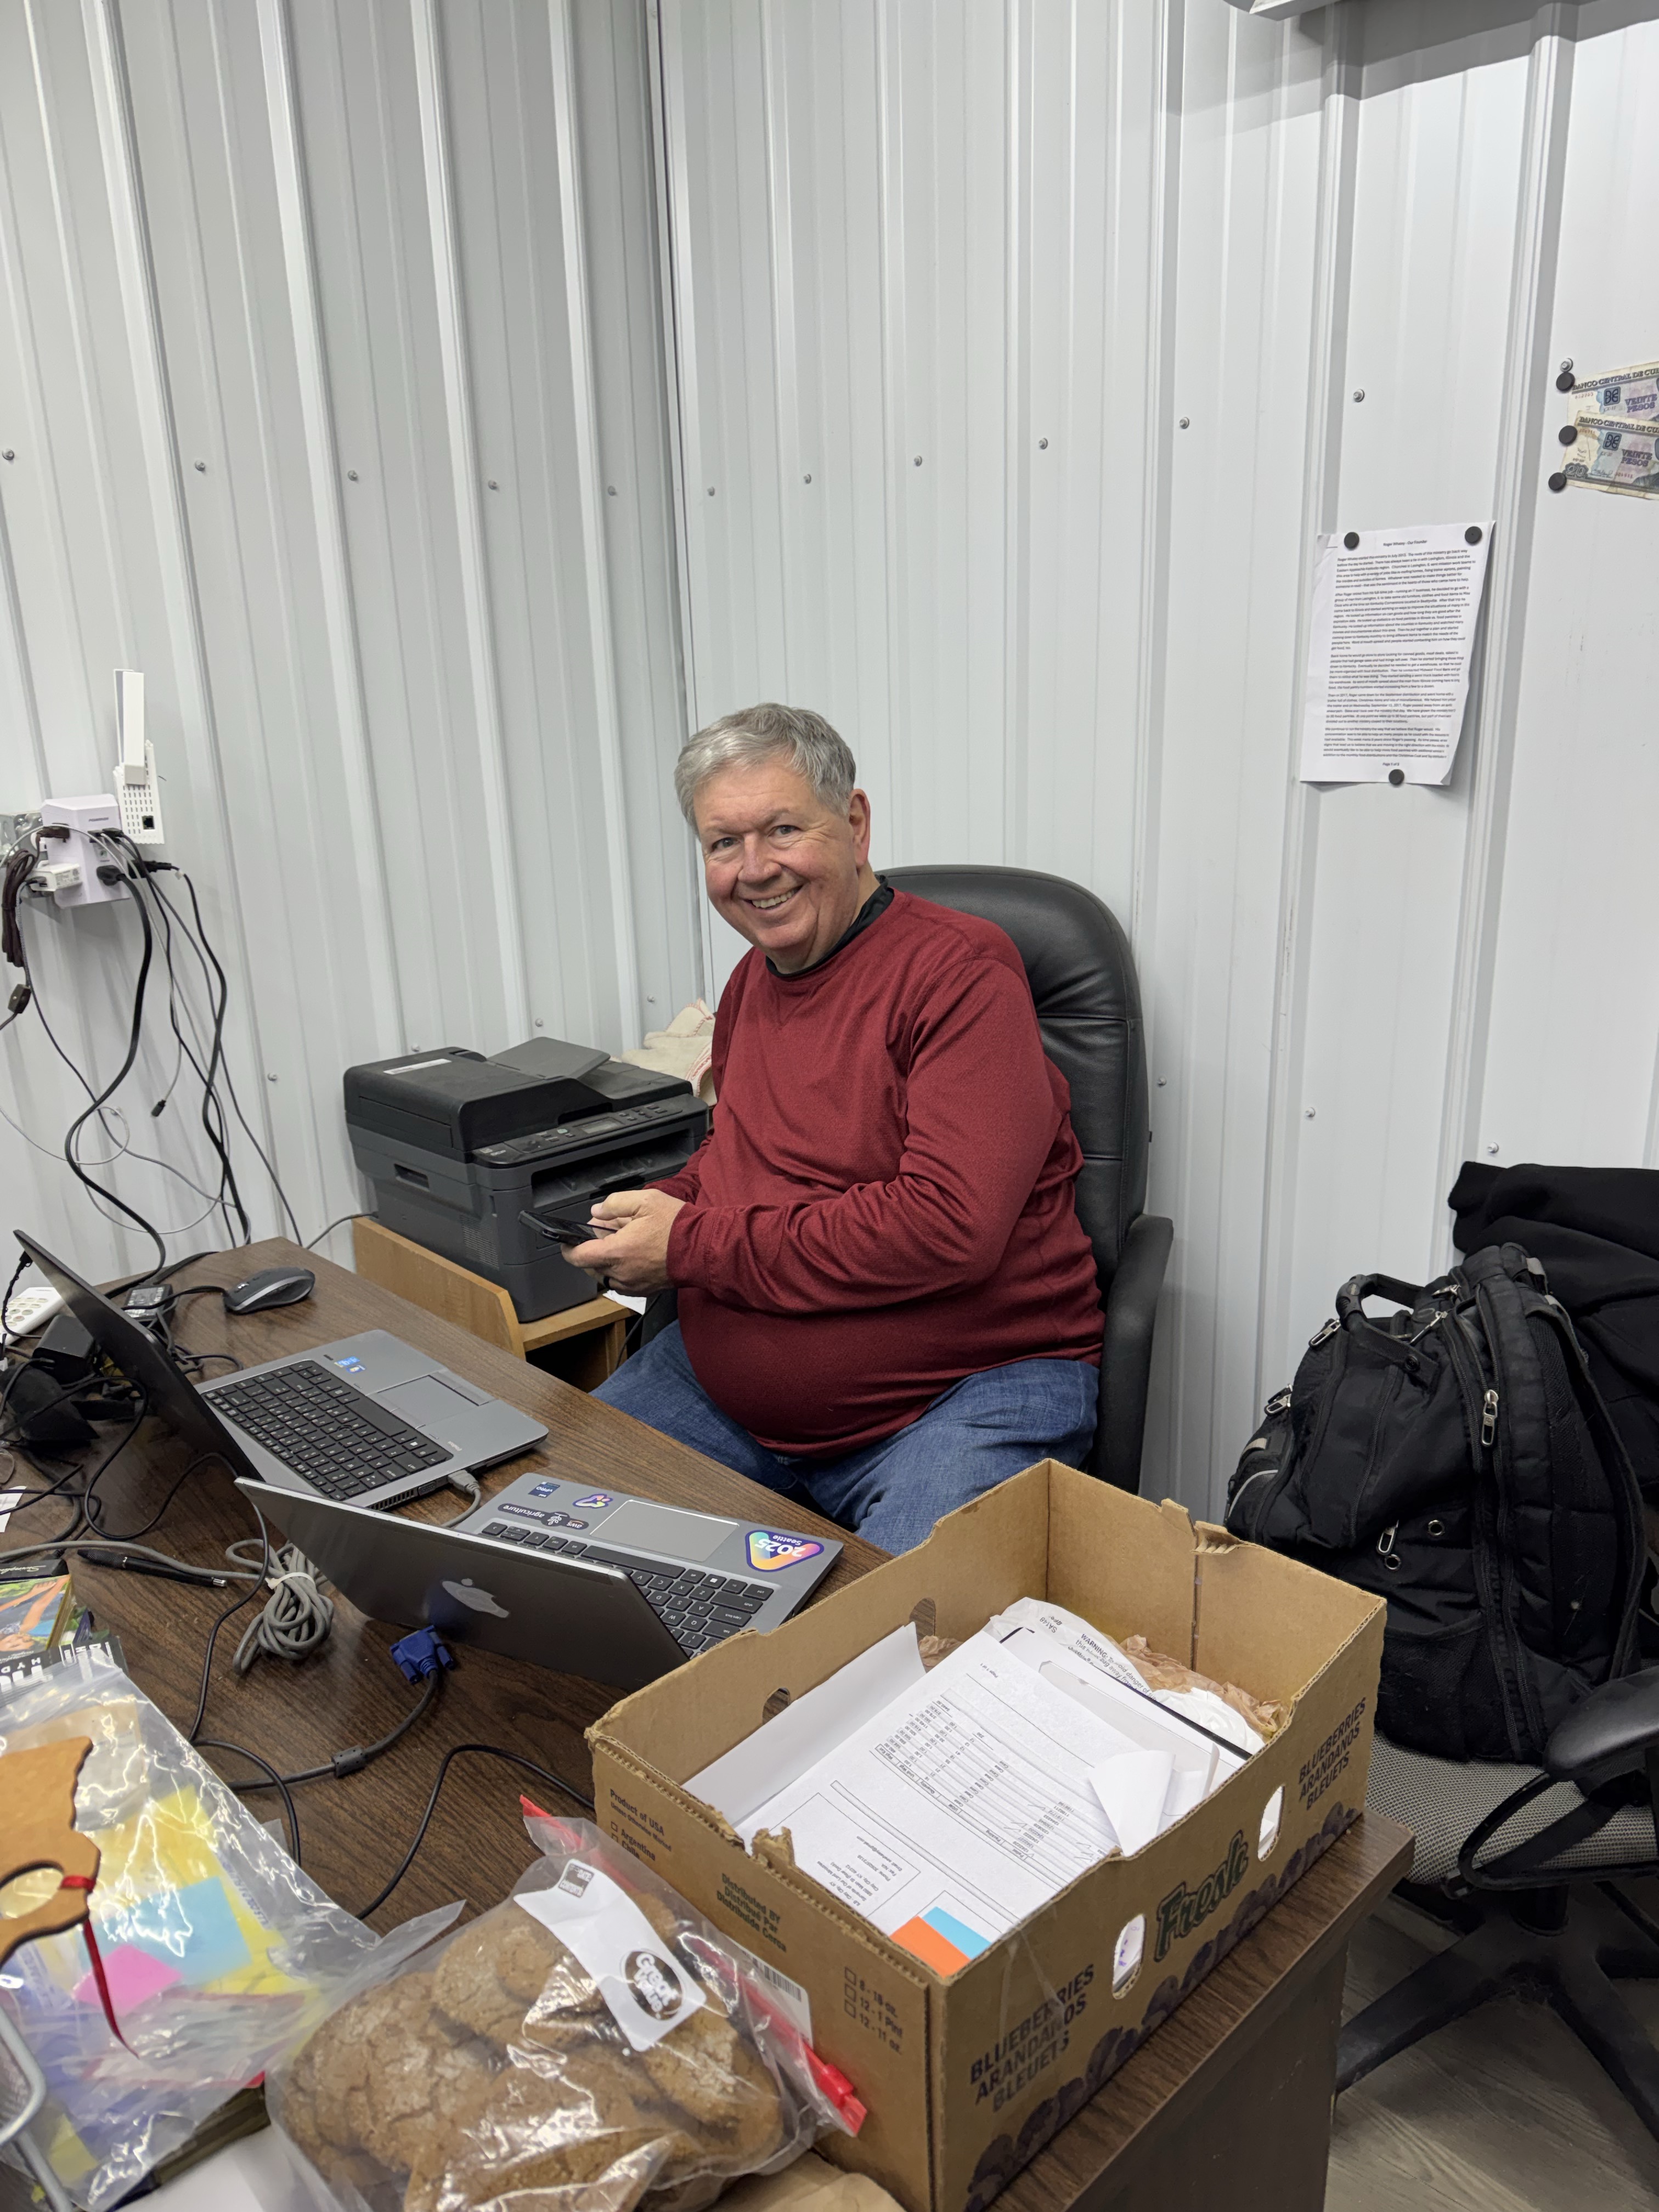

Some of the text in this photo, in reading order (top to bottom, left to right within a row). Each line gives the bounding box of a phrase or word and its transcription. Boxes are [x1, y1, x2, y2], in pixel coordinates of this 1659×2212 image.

[1573, 380, 1598, 390] BANCO
[1599, 373, 1632, 384] CENTRAL
[1625, 394, 1657, 405] VEINTE
[1627, 402, 1655, 413] PESOS
[1579, 416, 1603, 425] BANCO
[1604, 420, 1635, 430] CENTRAL
[1621, 456, 1649, 466] PESOS
[1622, 449, 1652, 460] VEINTE
[1567, 465, 1585, 478] 20
[503, 1505, 545, 1519] agriculture
[754, 1538, 806, 1557] 2025
[772, 1535, 802, 1545] Seattle
[1081, 1634, 1108, 1657] WARNING:
[1126, 1672, 1143, 1688] danger
[1109, 1666, 1122, 1678] away
[1299, 1696, 1365, 1784] BLUEBERRIES
[1299, 1720, 1359, 1801] ARANDANOS
[1306, 1750, 1349, 1811] BLEUETS
[610, 1788, 664, 1836] Product of USA
[611, 1802, 627, 1818] Unless
[628, 1815, 651, 1836] Otherwise
[621, 1829, 655, 1861] Argentina
[622, 1841, 640, 1859] Chile
[722, 1873, 780, 1923] Distributed BY
[1154, 1830, 1249, 1962] Fresh
[764, 1916, 777, 1933] Par
[763, 1928, 787, 1953] Cerca
[634, 1968, 664, 2013] Value
[635, 1953, 679, 2006] Great
[860, 1995, 869, 2012] 12
[885, 2015, 902, 2038] Pint
[860, 2012, 869, 2028] 12
[971, 1963, 1093, 2084] BLUEBERRIES
[992, 2028, 1069, 2114] BLEUETS
